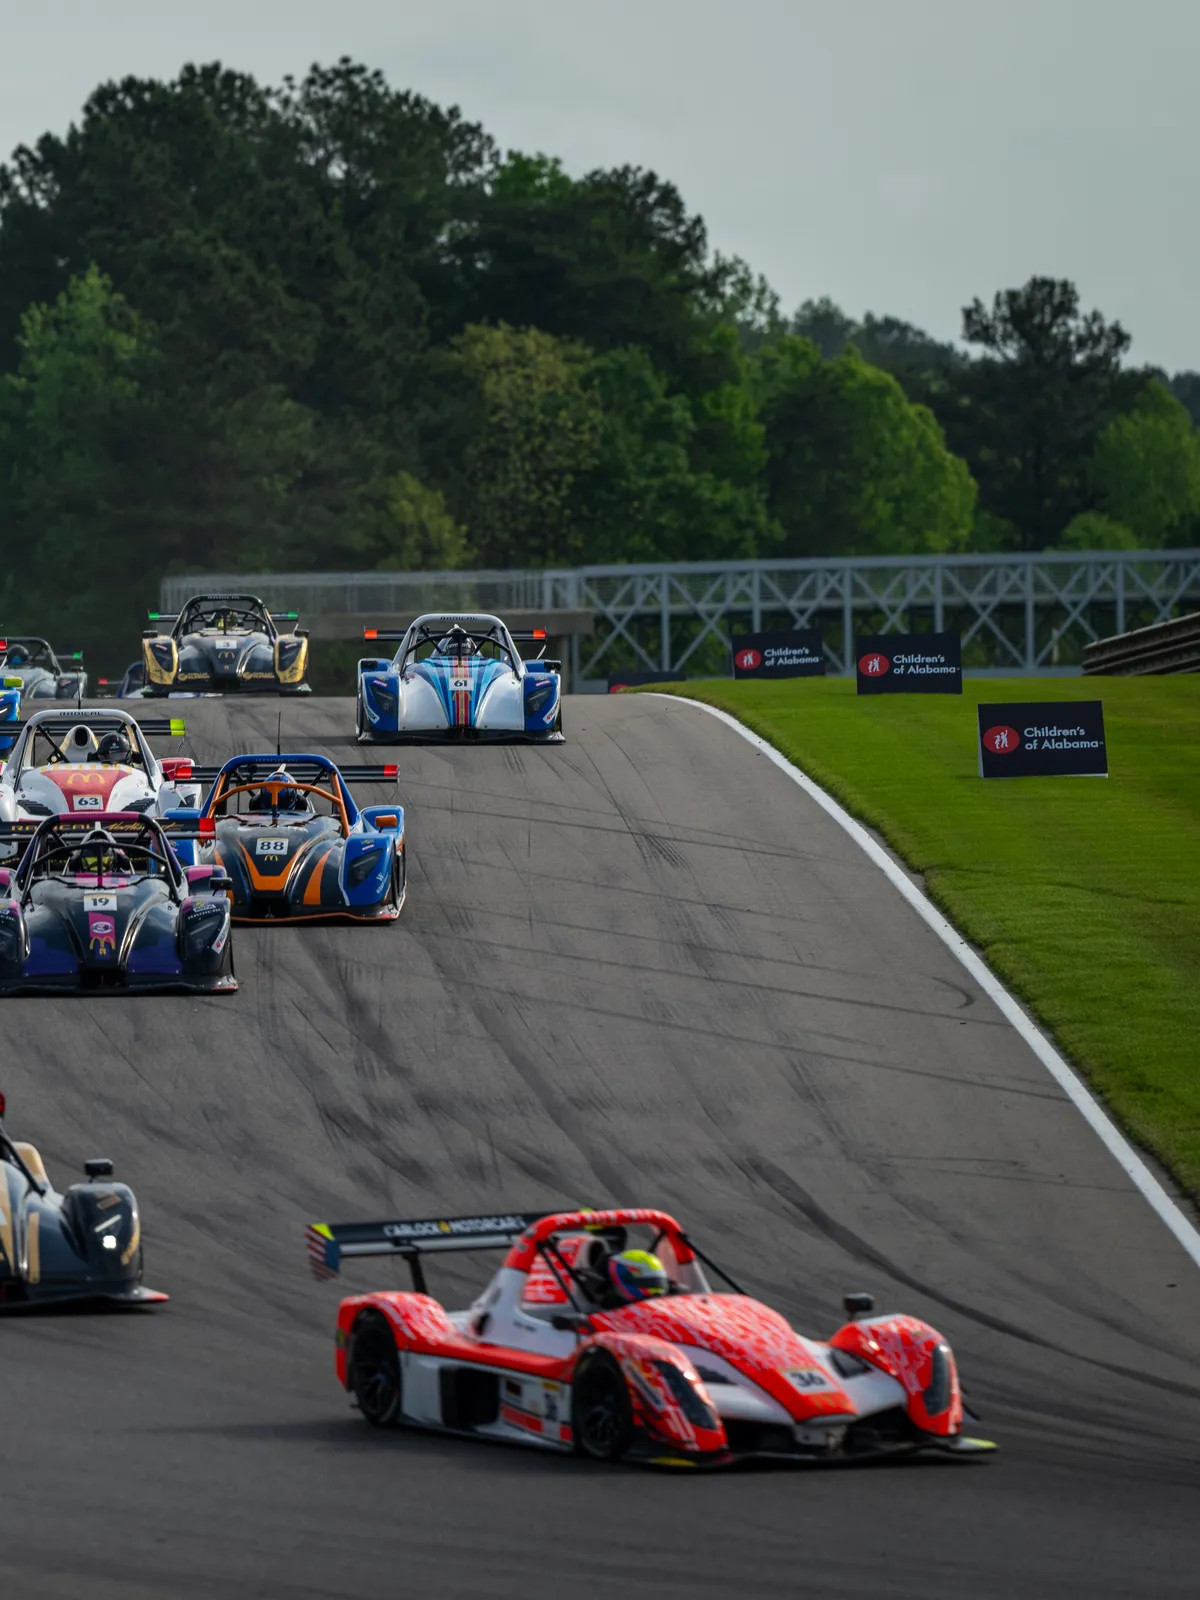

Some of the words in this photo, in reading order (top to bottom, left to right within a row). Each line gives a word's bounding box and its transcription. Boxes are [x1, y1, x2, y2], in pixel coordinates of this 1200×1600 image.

[764, 647, 810, 657] Children's
[765, 657, 776, 666] of
[777, 655, 819, 665] Alabama
[893, 653, 945, 664] Children's
[893, 664, 906, 675] of
[907, 664, 956, 674] Alabama
[453, 679, 468, 687] 61
[1023, 726, 1085, 738] Children's
[1024, 739, 1039, 751] of
[1041, 738, 1099, 750] Alabama
[77, 796, 99, 807] 63
[10, 823, 92, 832] RAICAL
[259, 840, 285, 851] 88
[91, 896, 109, 907] 19
[790, 1371, 827, 1388] 36
